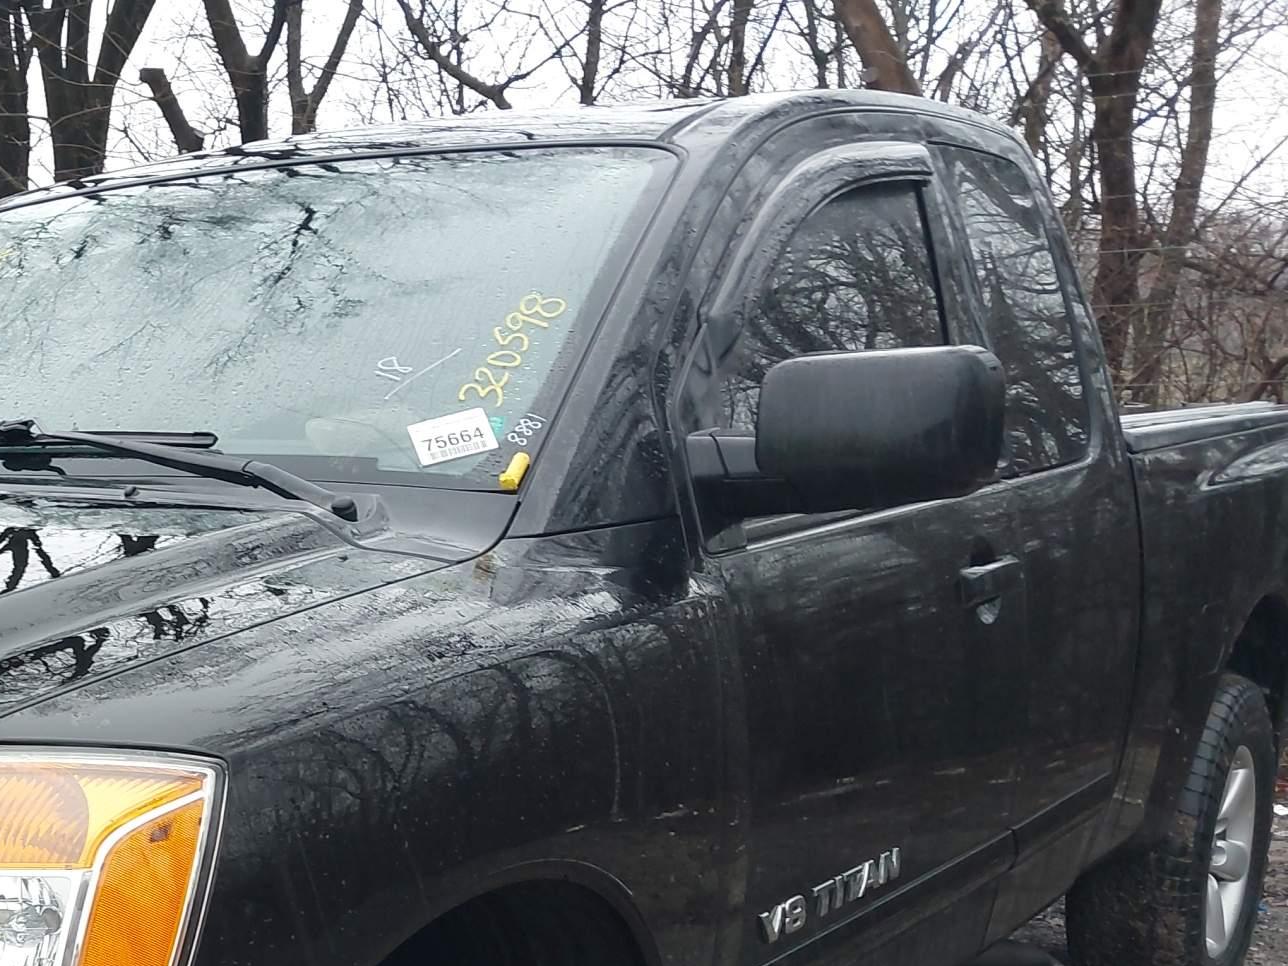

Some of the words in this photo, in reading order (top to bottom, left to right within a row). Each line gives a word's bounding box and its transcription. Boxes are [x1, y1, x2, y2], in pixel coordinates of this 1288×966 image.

[421, 427, 485, 452] 75664
[758, 894, 807, 944] V8
[812, 847, 900, 917] TITAN
